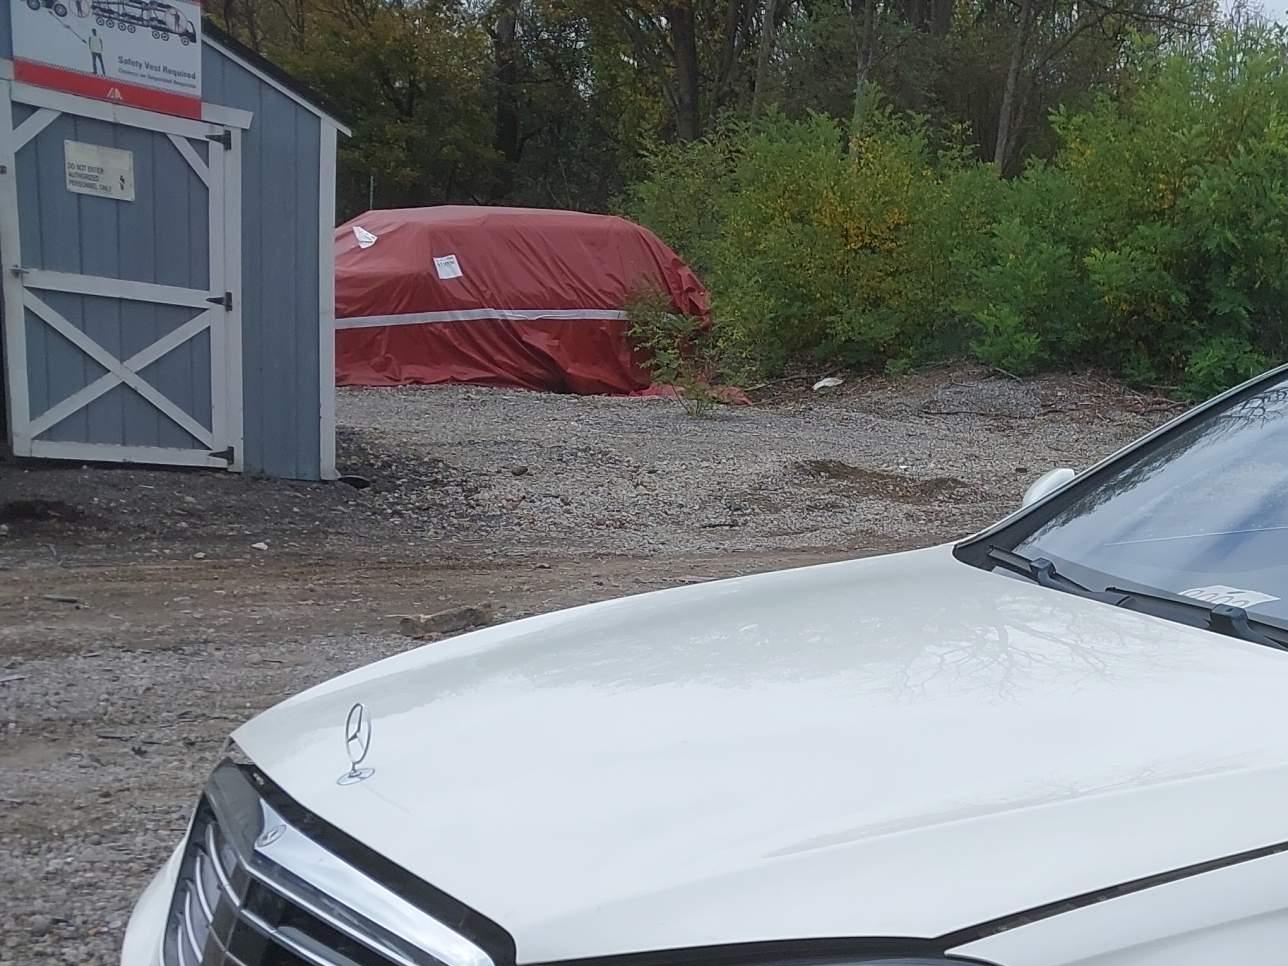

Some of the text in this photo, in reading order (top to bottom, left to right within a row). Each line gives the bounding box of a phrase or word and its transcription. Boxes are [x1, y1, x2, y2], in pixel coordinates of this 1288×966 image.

[118, 55, 143, 70] Safety
[144, 60, 161, 72] Vest
[162, 64, 196, 80] Required
